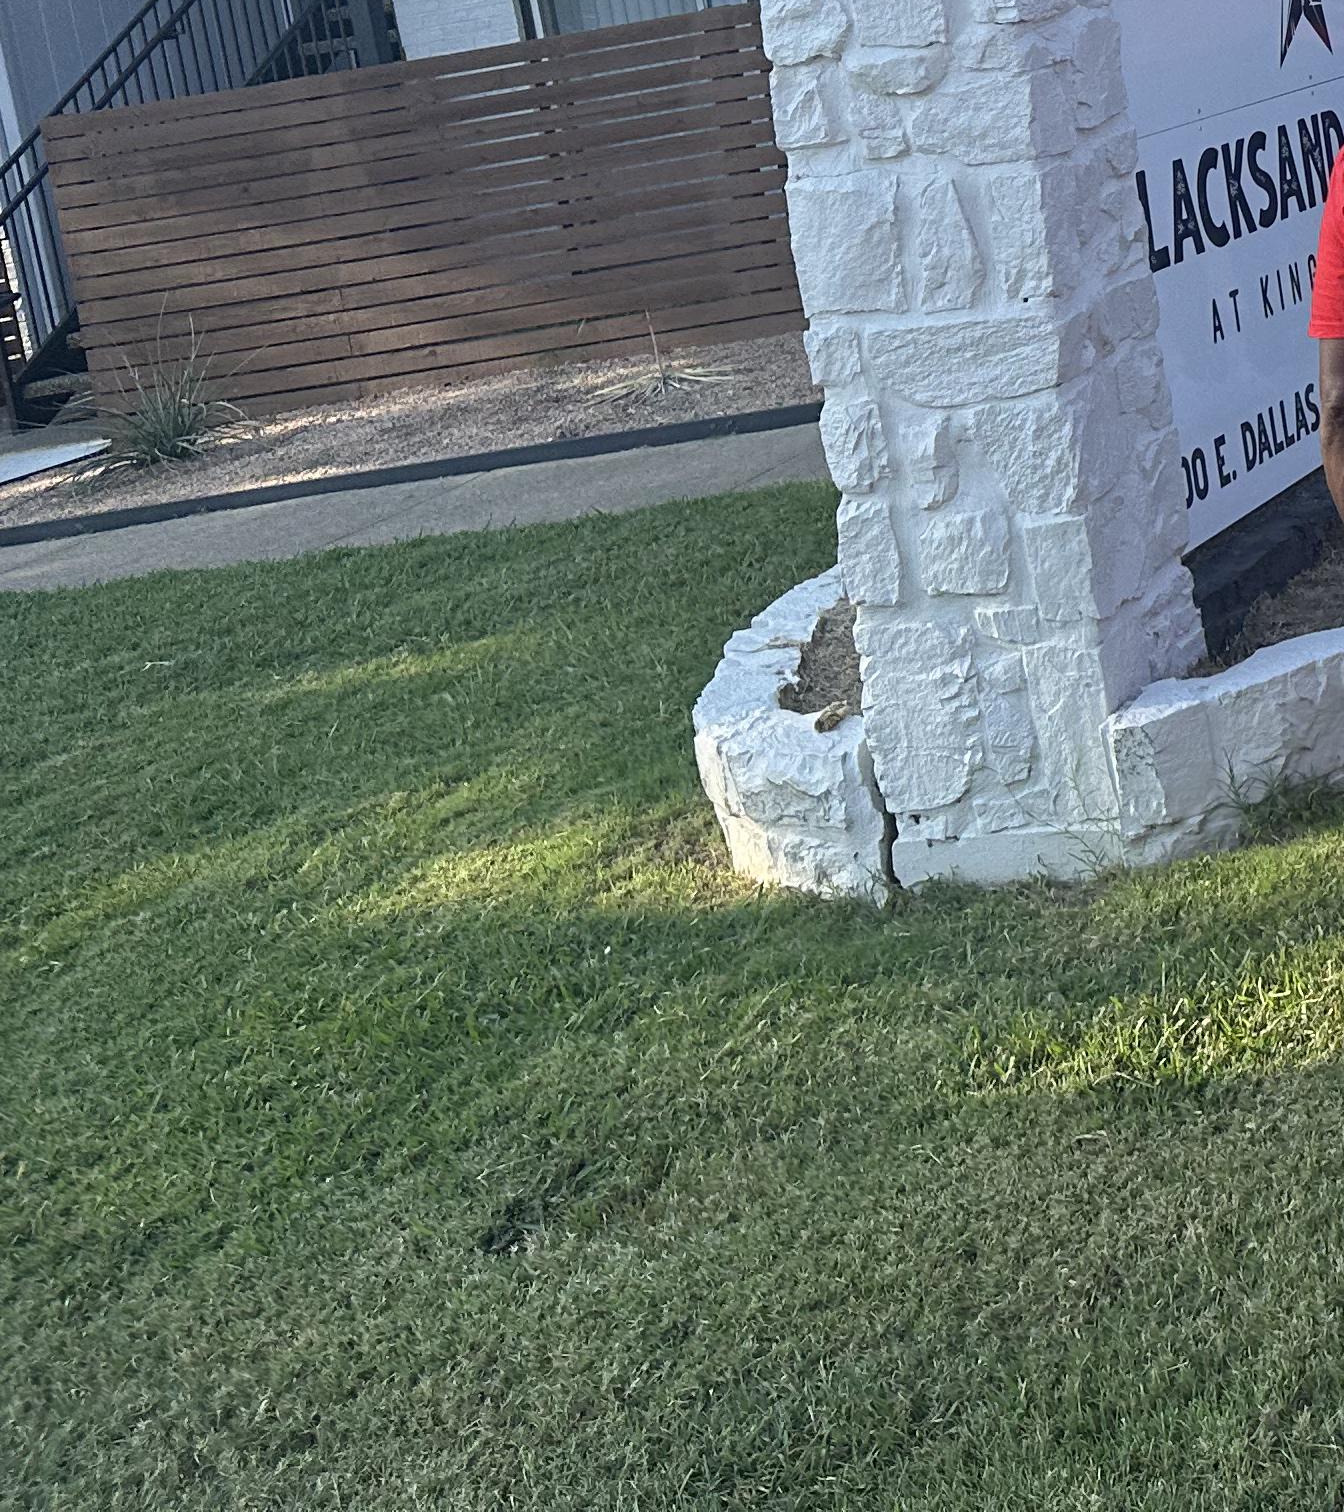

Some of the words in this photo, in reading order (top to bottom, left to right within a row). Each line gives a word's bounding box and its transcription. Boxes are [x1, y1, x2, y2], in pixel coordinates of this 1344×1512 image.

[1212, 288, 1241, 344] AT
[1214, 433, 1237, 489] E.
[1241, 383, 1321, 473] DALLAS
